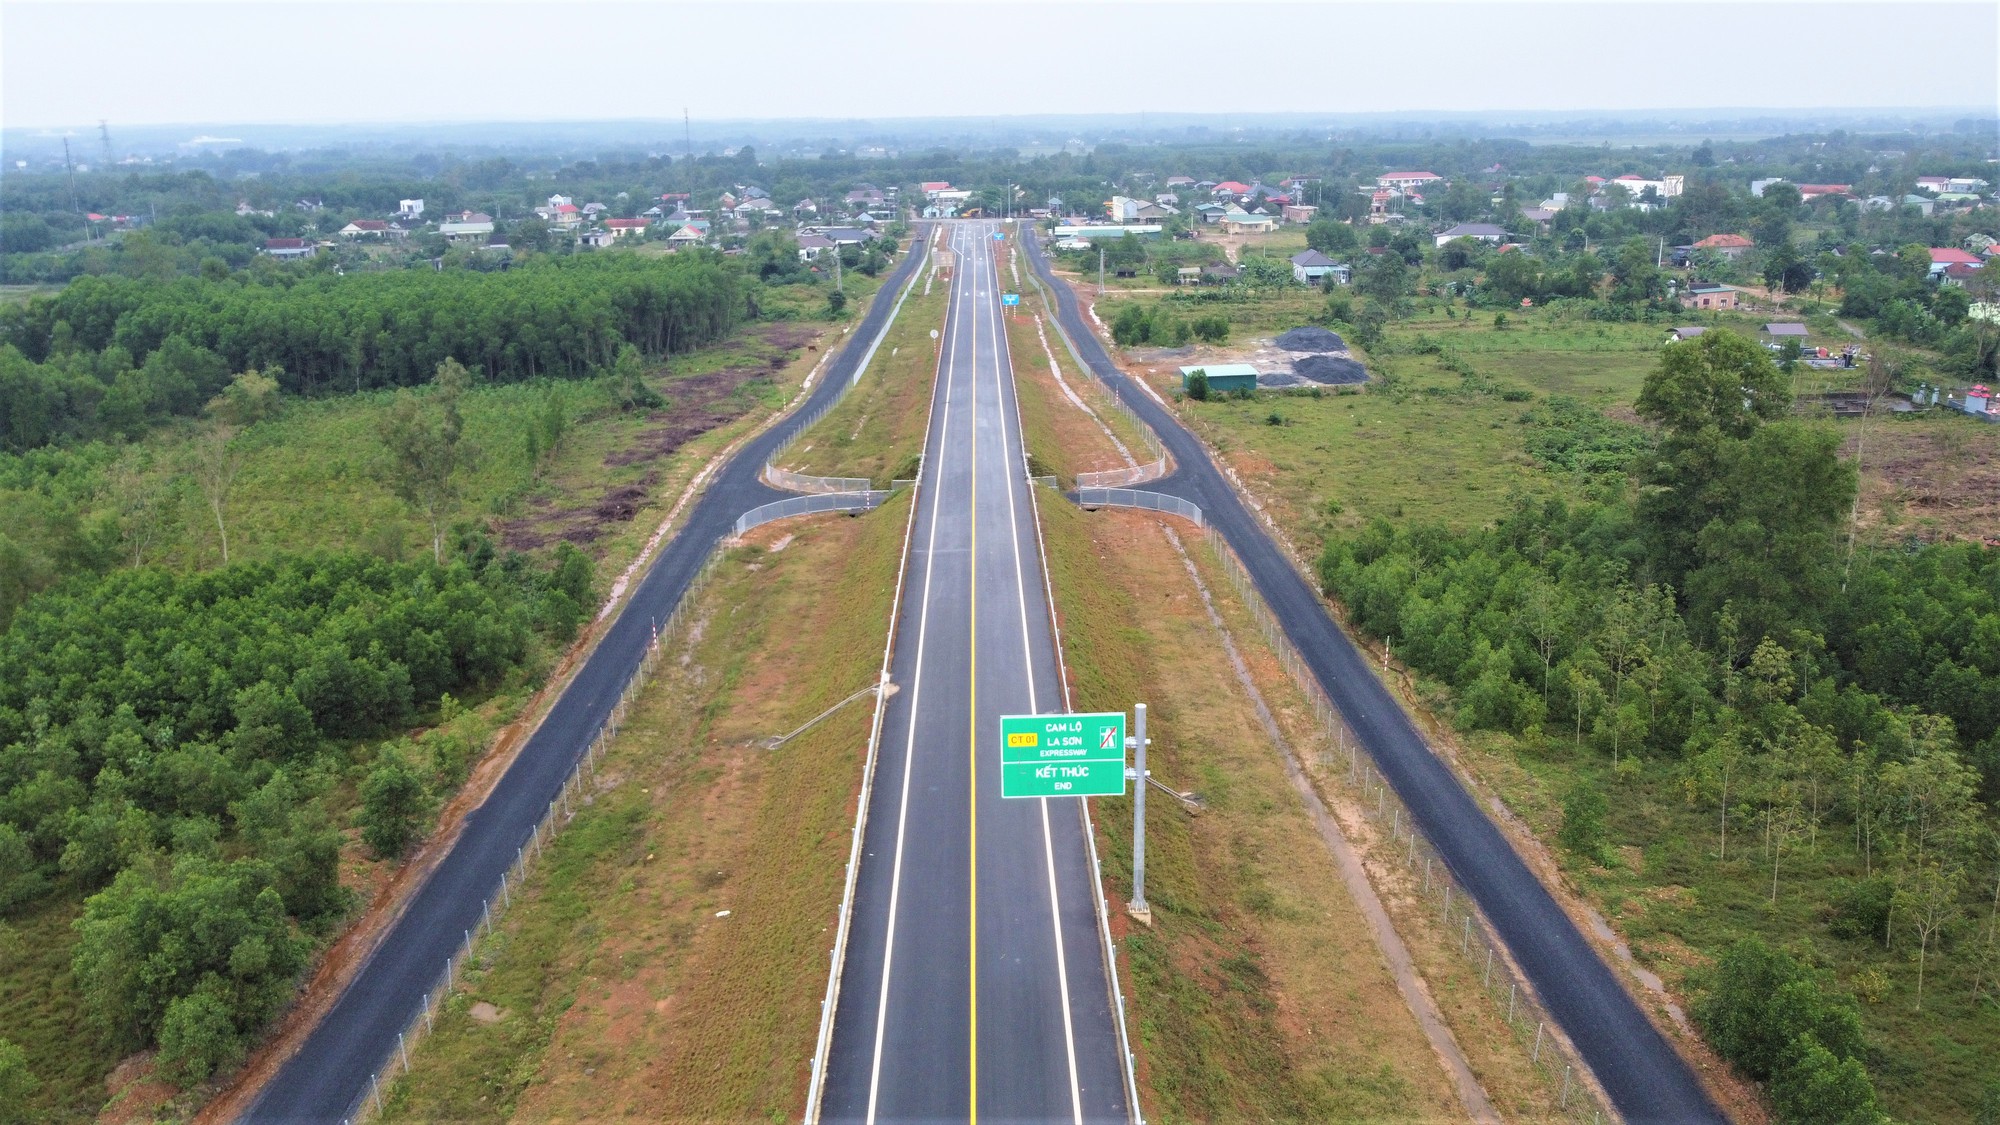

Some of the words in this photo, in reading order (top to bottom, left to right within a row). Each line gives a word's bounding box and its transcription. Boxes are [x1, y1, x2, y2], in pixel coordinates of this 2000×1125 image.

[1045, 723, 1067, 732] CAM
[1069, 721, 1082, 733] LỘ
[1011, 736, 1023, 744] CT
[1026, 735, 1035, 743] 01
[1047, 738, 1061, 746] LA
[1062, 737, 1082, 746] SƠN
[1040, 749, 1087, 757] EXPRESSWAY
[1035, 764, 1057, 778] KẾT
[1060, 765, 1089, 777] THÚC
[1054, 782, 1072, 790] END
